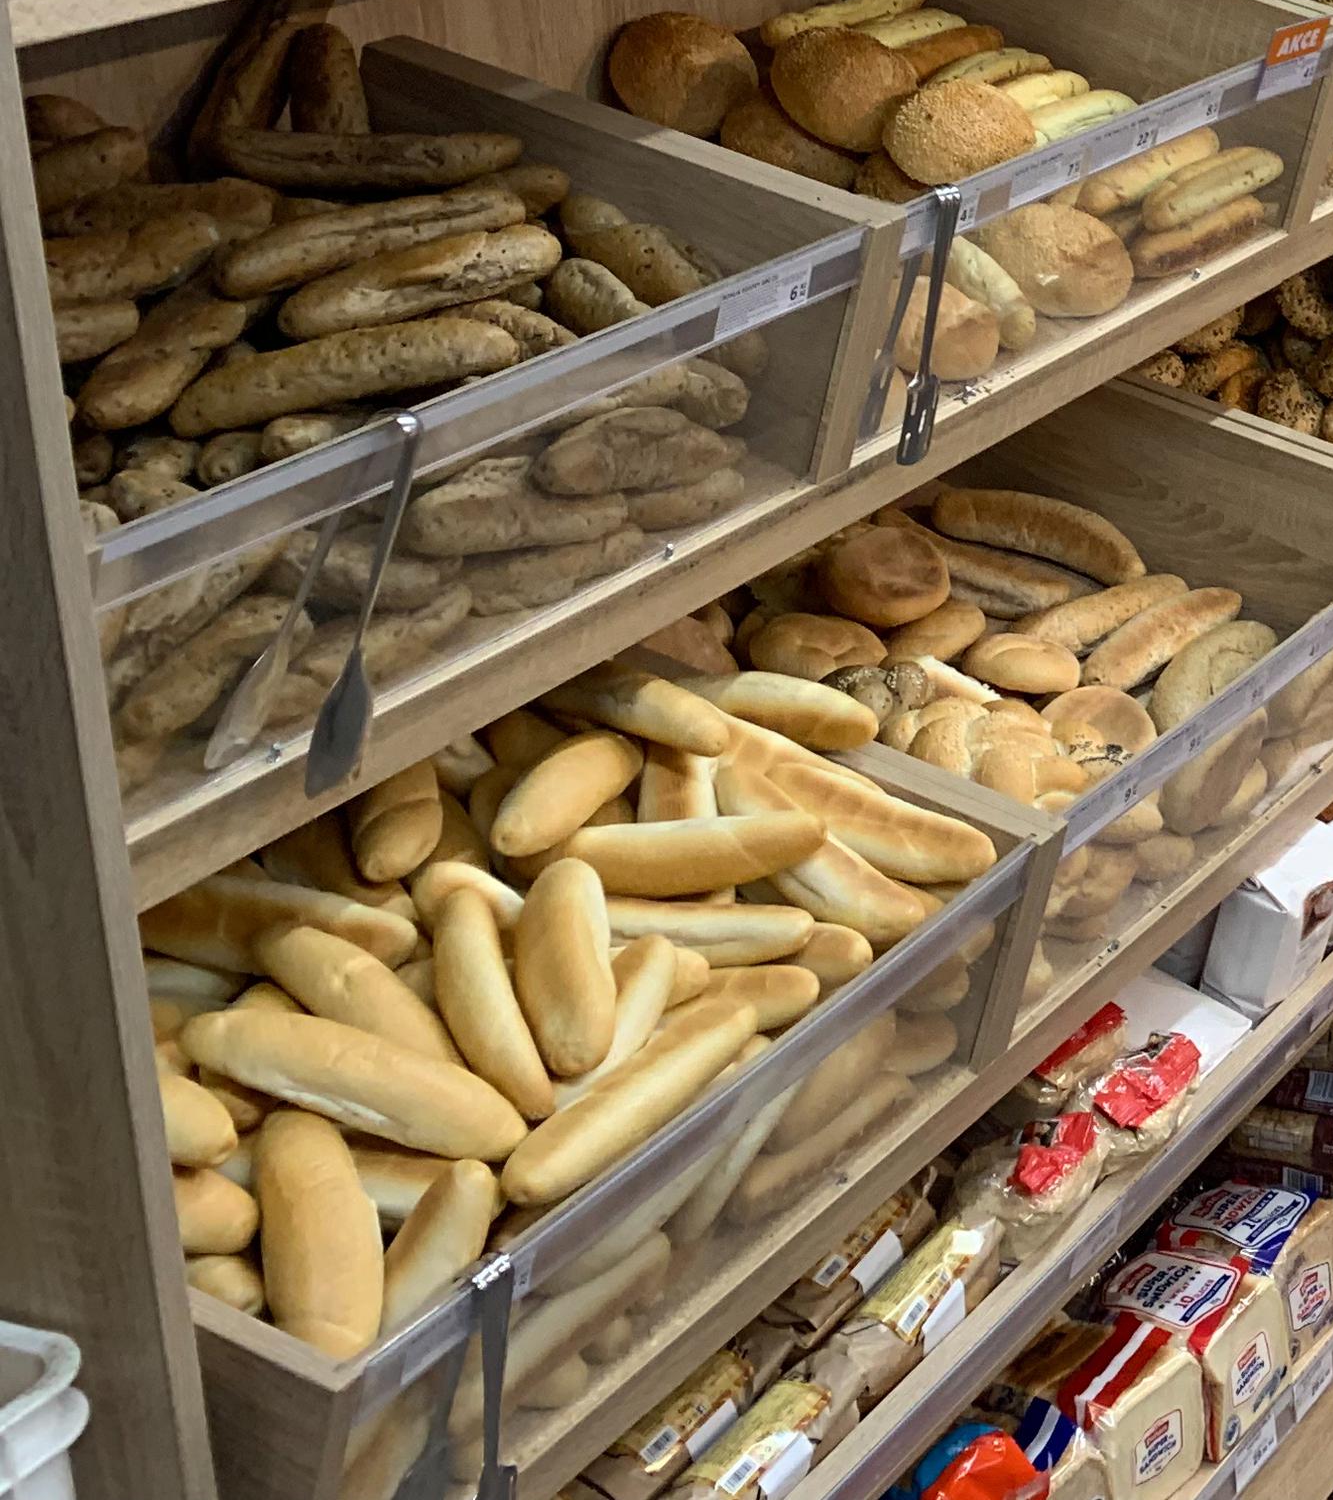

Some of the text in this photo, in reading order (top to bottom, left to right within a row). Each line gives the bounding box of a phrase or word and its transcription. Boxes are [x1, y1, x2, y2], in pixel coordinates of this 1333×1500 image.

[1276, 28, 1321, 58] AKCE
[1137, 131, 1150, 147] 22
[790, 285, 798, 300] 6
